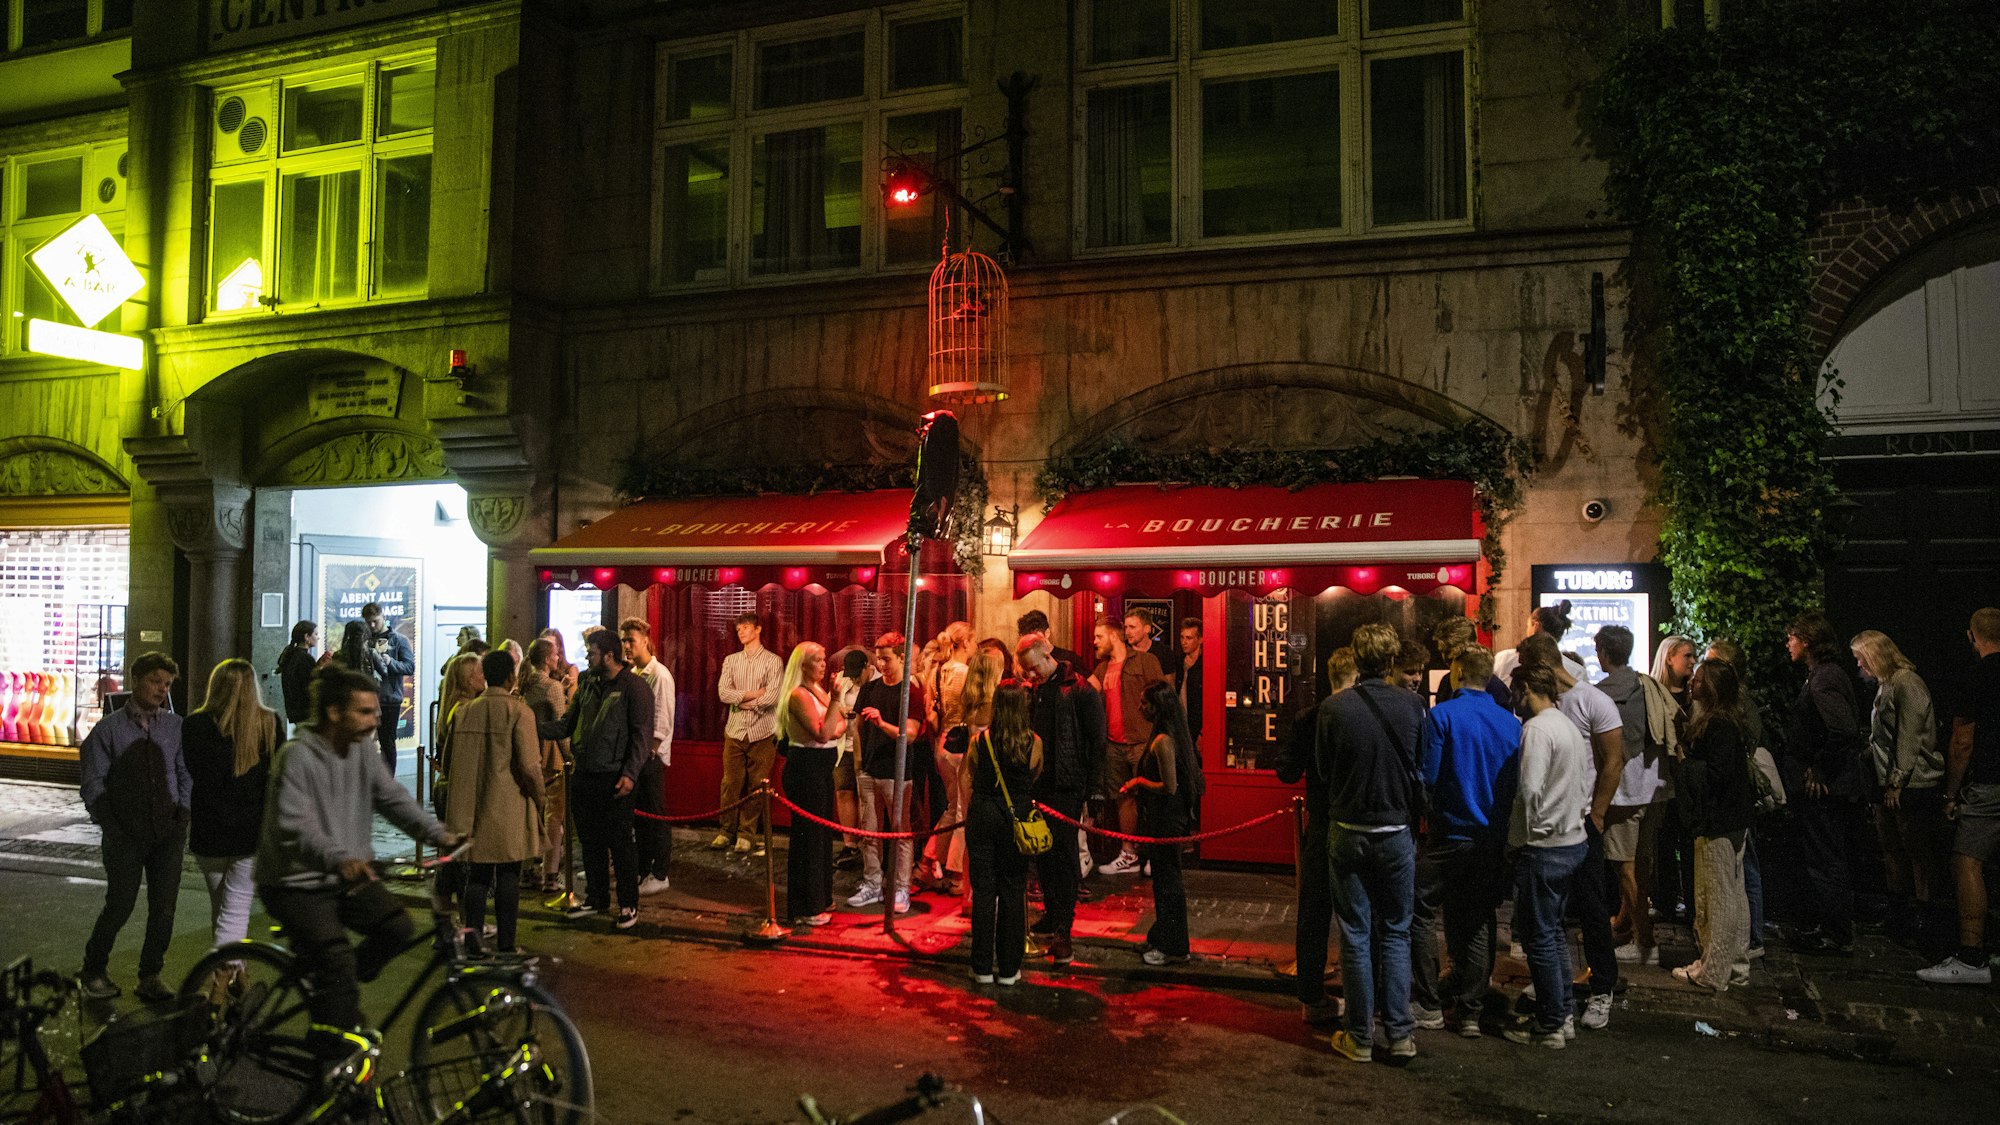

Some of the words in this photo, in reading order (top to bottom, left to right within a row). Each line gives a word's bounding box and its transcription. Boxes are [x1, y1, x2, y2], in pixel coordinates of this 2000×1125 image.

[656, 520, 859, 535] BOUCHERIE
[1139, 512, 1393, 533] BOUCHERIE
[673, 568, 724, 582] OUCHER
[1037, 578, 1060, 586] UBORG
[1407, 572, 1436, 580] TUBORG
[1554, 571, 1634, 590] TUBORG
[378, 591, 404, 603] ALLE
[340, 606, 363, 618] UGE
[382, 605, 404, 616] AGE
[1566, 606, 1630, 622] OCKTAILS
